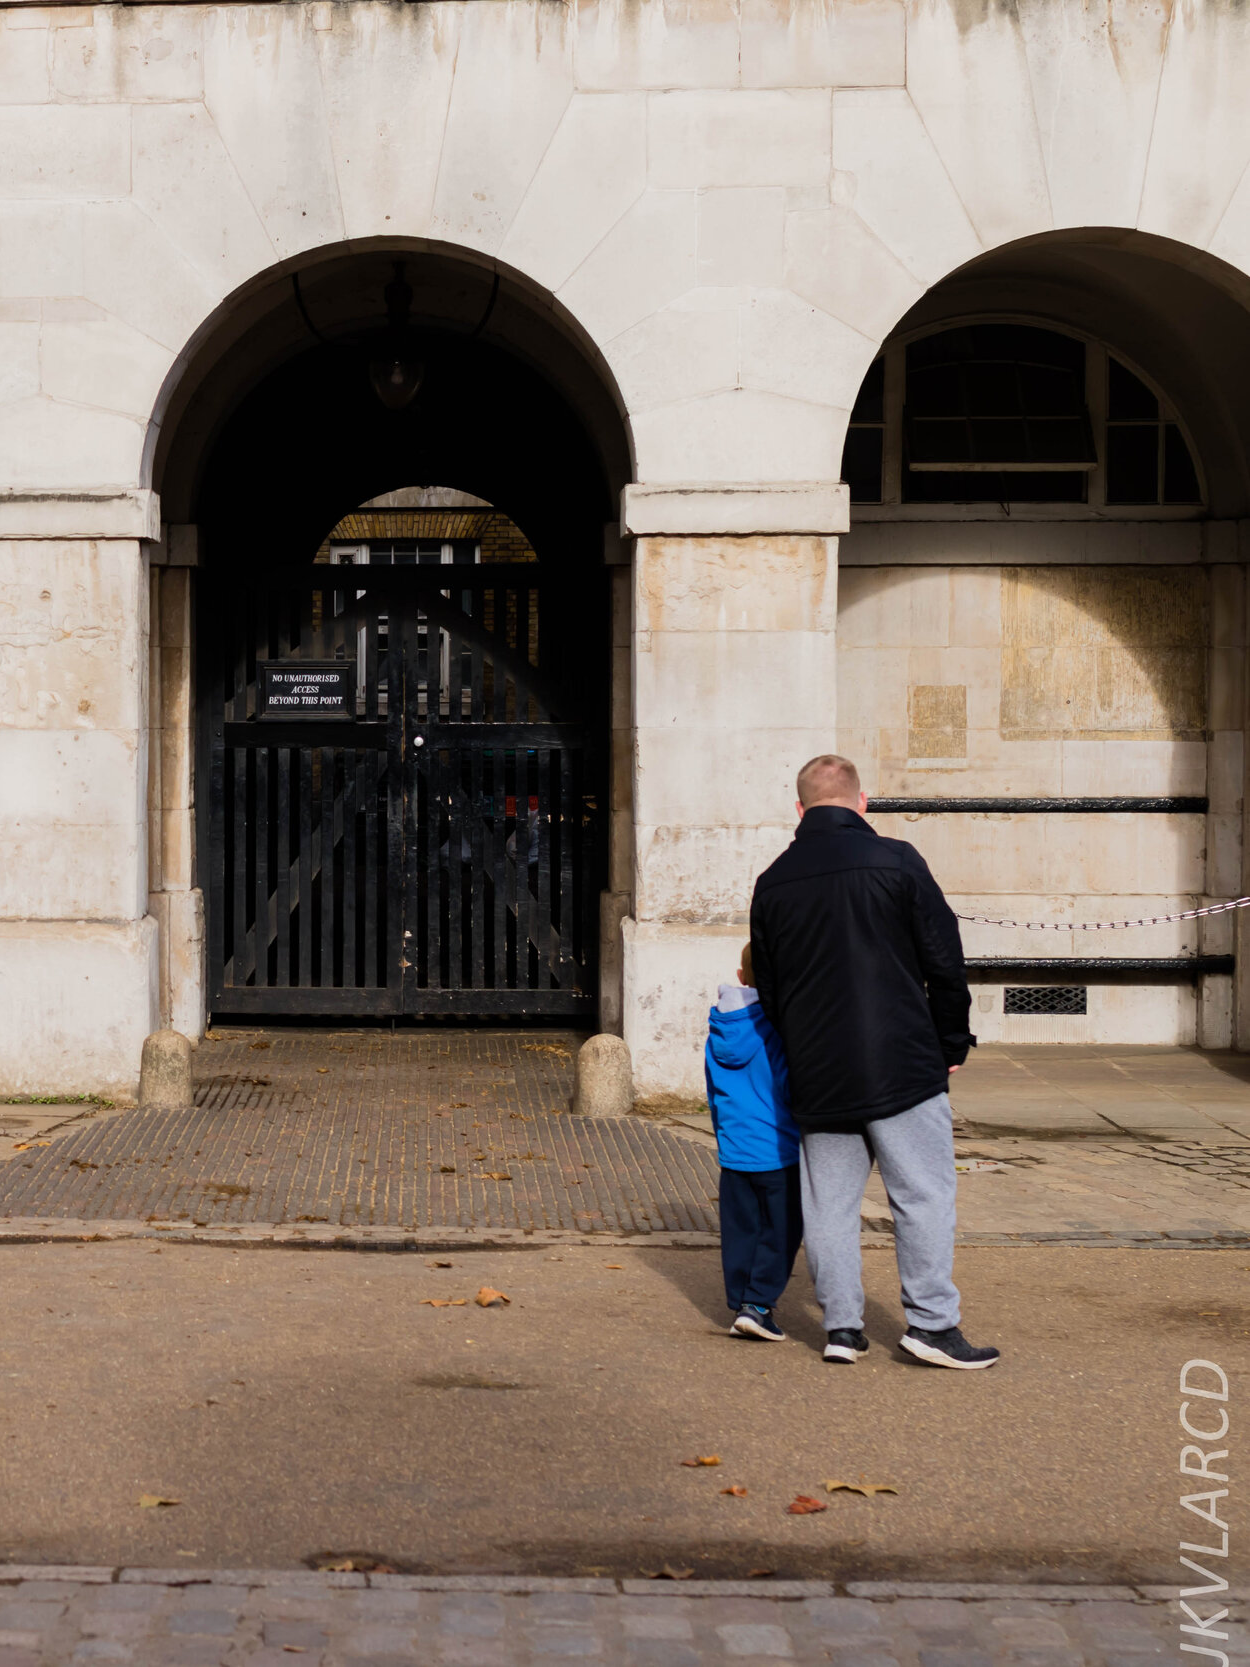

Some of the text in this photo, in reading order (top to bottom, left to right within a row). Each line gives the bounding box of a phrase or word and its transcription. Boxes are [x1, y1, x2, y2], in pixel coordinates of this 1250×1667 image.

[272, 674, 340, 682] NO UNAUTHORISED
[291, 686, 319, 694] ACCESS
[268, 696, 342, 704] BEYOND THIS POINT
